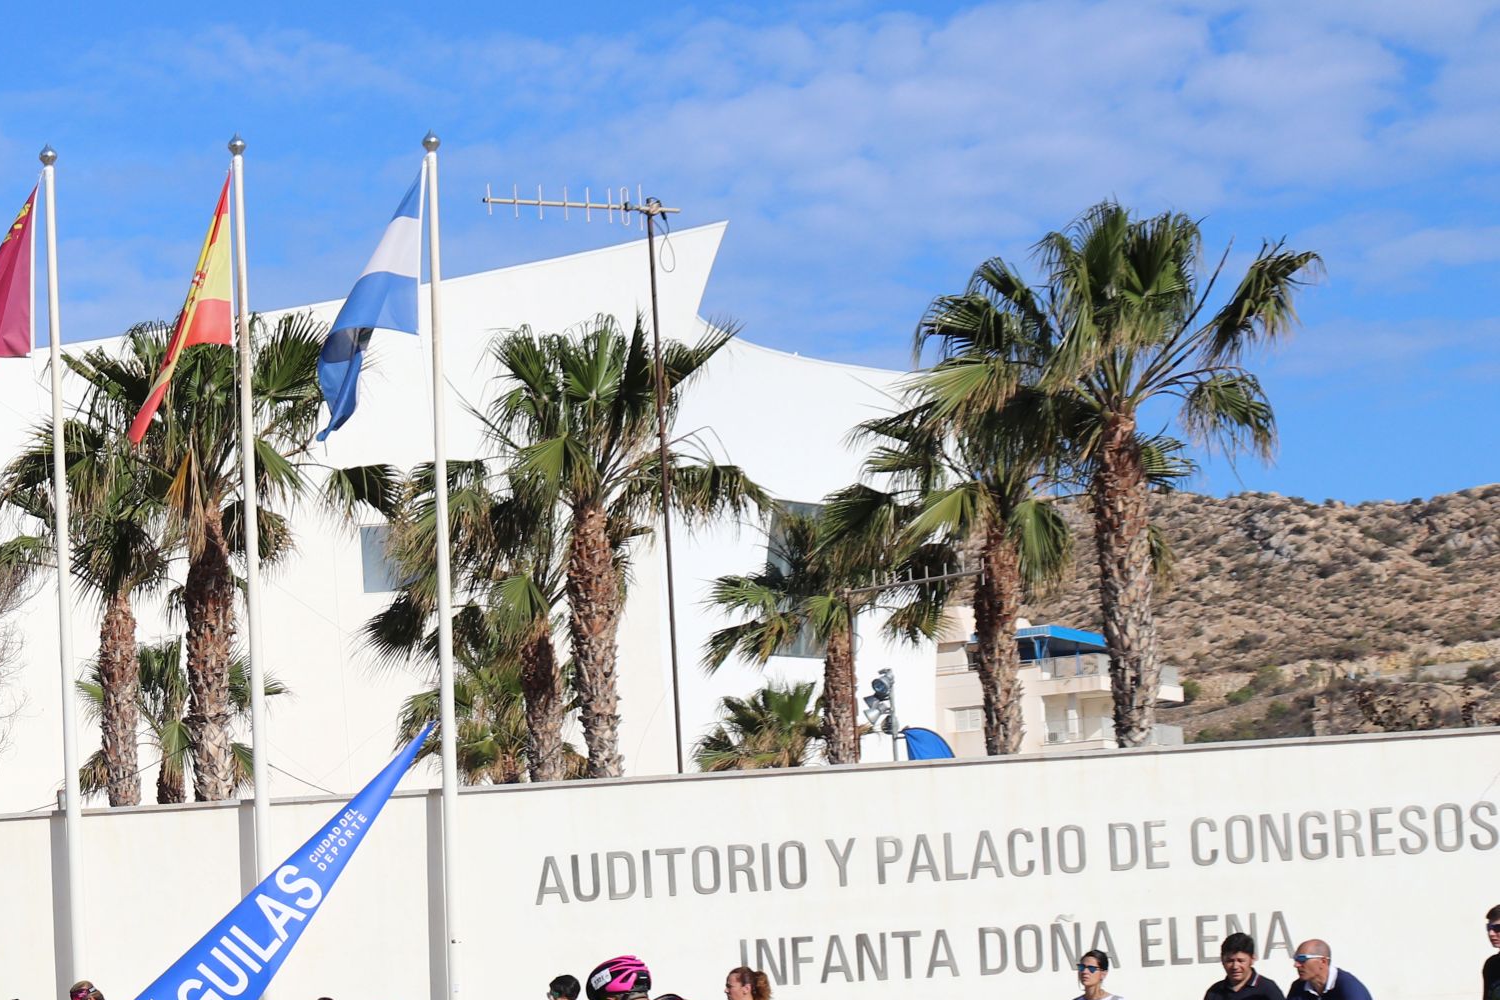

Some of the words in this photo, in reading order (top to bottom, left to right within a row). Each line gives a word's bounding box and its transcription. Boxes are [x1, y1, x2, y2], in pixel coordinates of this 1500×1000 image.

[308, 825, 342, 863] CIUDAD
[339, 808, 359, 827] DEL
[317, 812, 368, 872] DEPORTE
[536, 841, 807, 905] AUDITORIO
[826, 838, 855, 887] Y
[877, 825, 1086, 884] PALACIO
[1109, 821, 1170, 871] DE
[1190, 800, 1499, 866] CONGRESOS
[740, 928, 961, 986] INFANTA
[978, 914, 1121, 976] DOÑA
